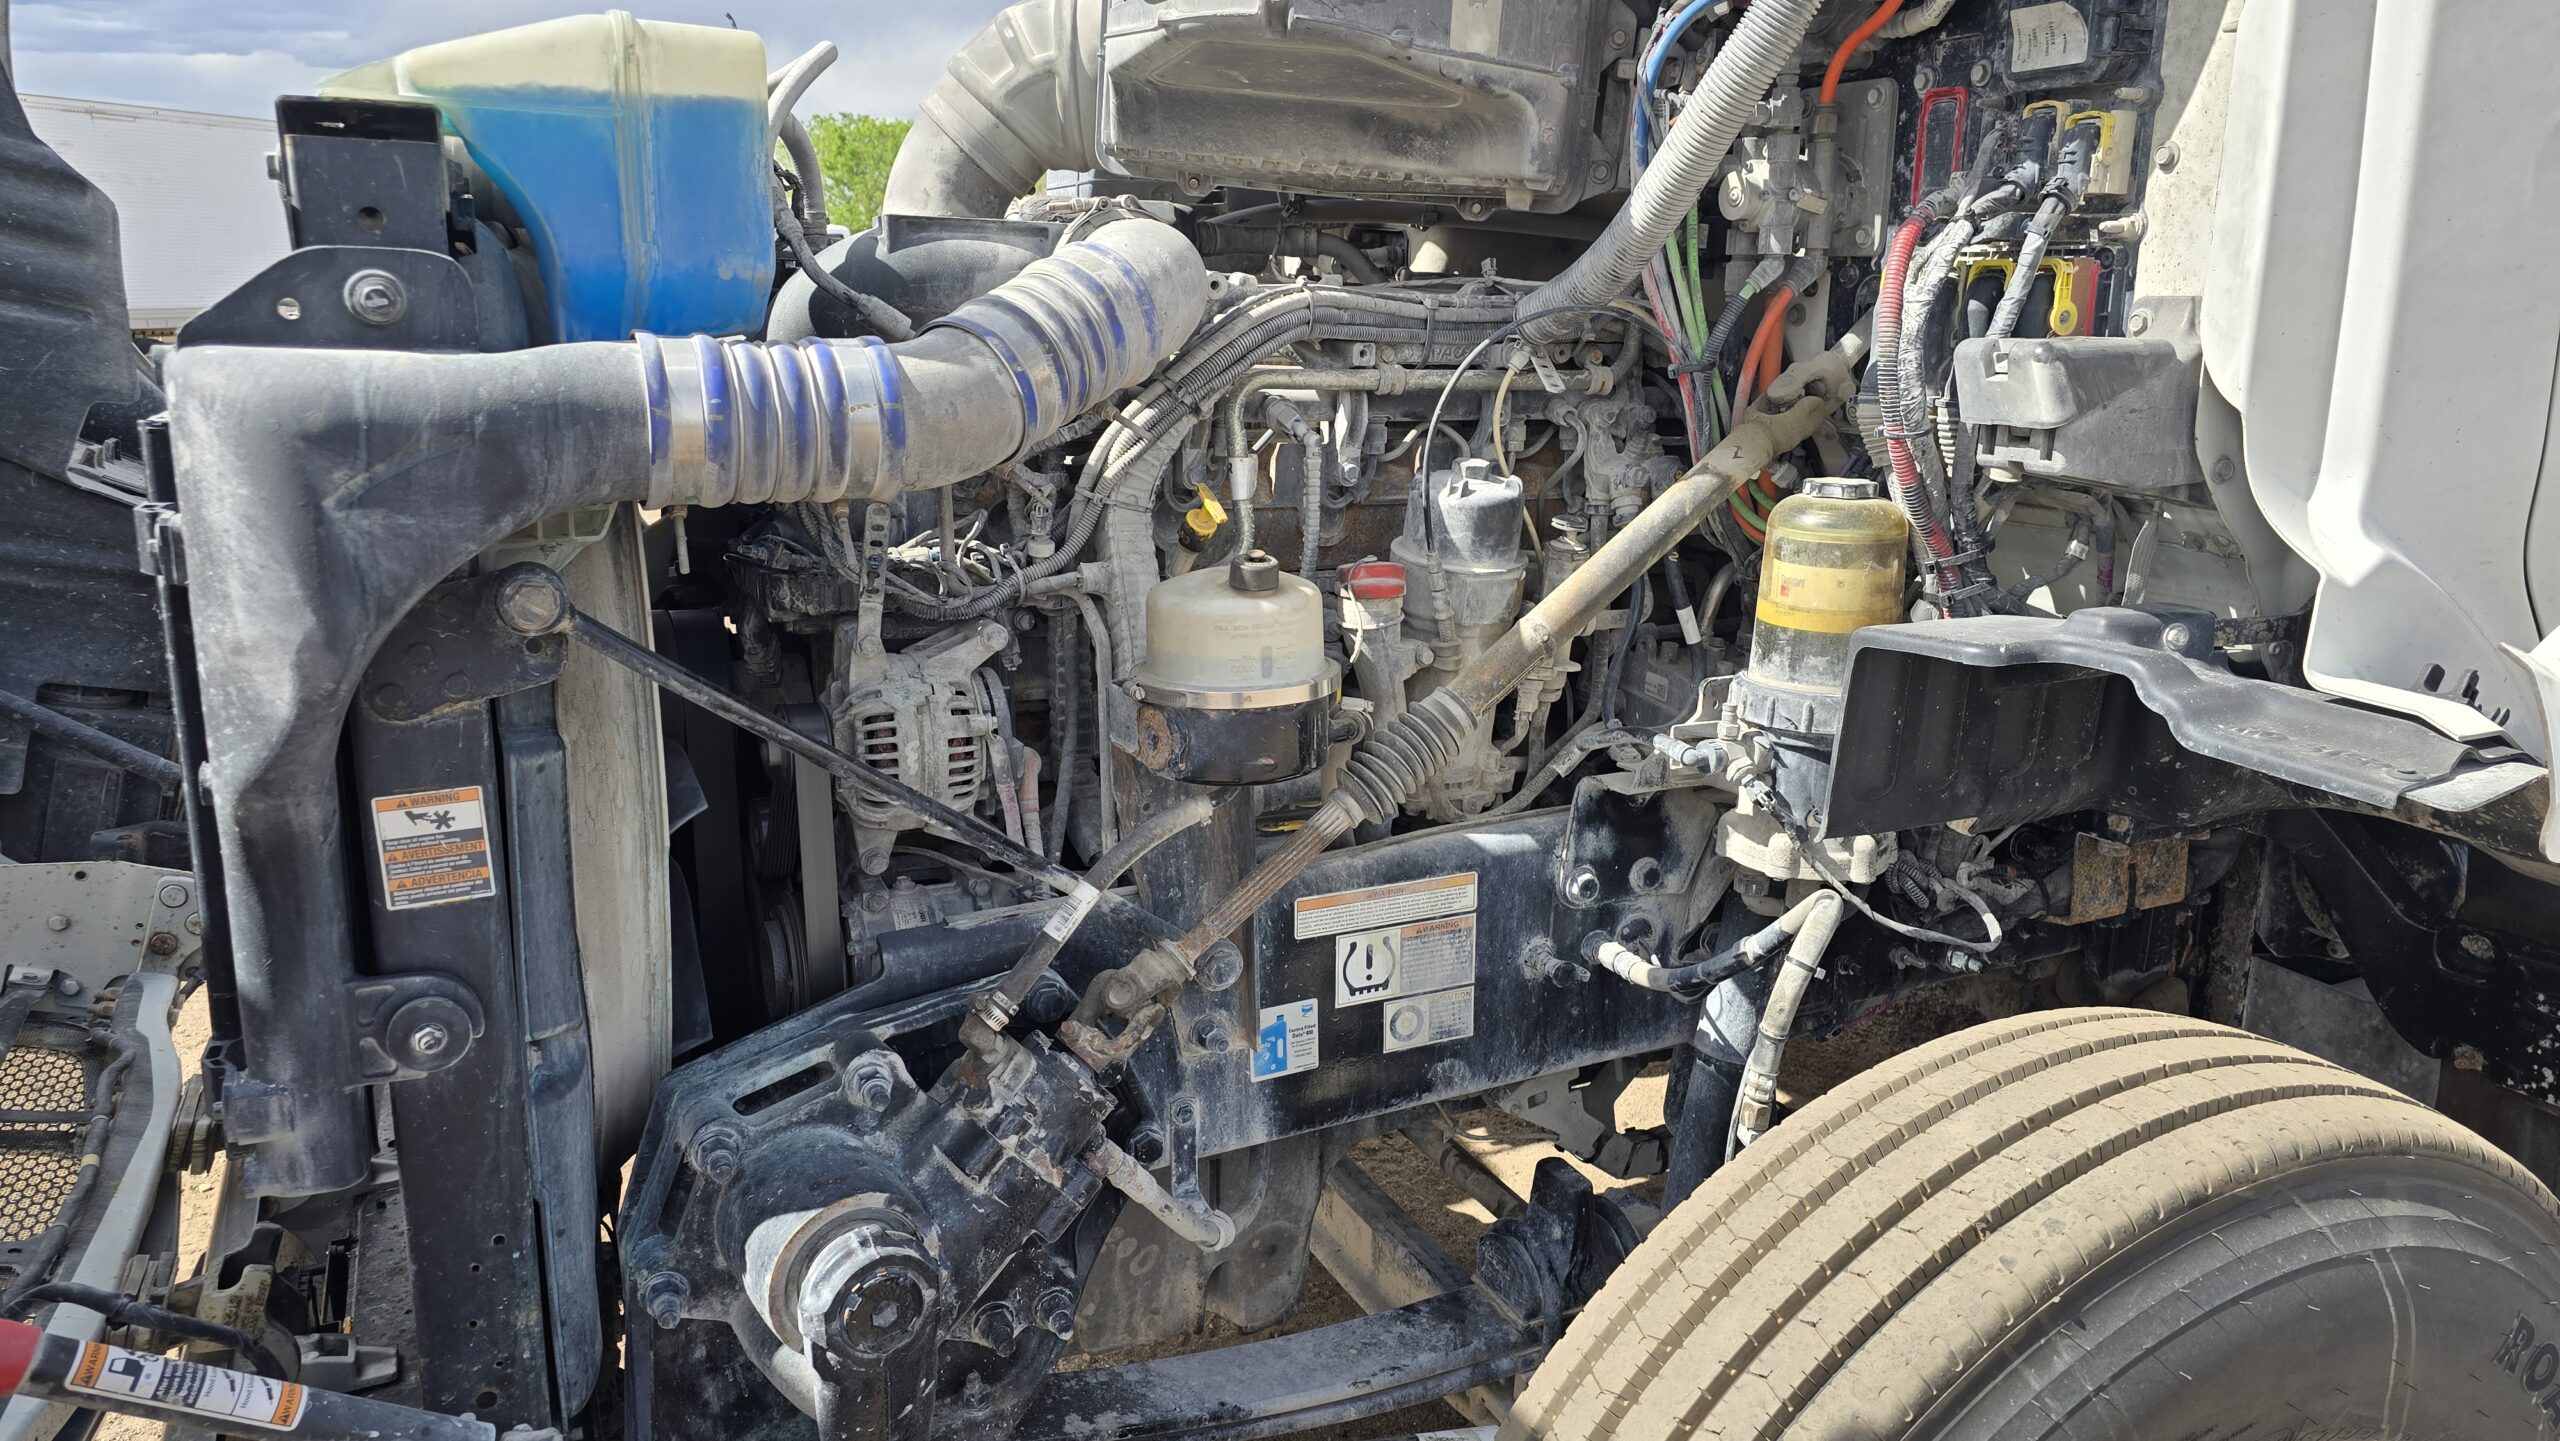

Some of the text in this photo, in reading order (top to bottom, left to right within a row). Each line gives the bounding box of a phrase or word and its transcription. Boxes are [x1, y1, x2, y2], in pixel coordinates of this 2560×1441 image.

[409, 791, 460, 807] WARNING
[401, 841, 484, 860] AVERTISSEMENT
[411, 869, 483, 887] ADVERTENCIA
[1372, 886, 1408, 897] WARNIN
[1422, 920, 1460, 934] WARNING
